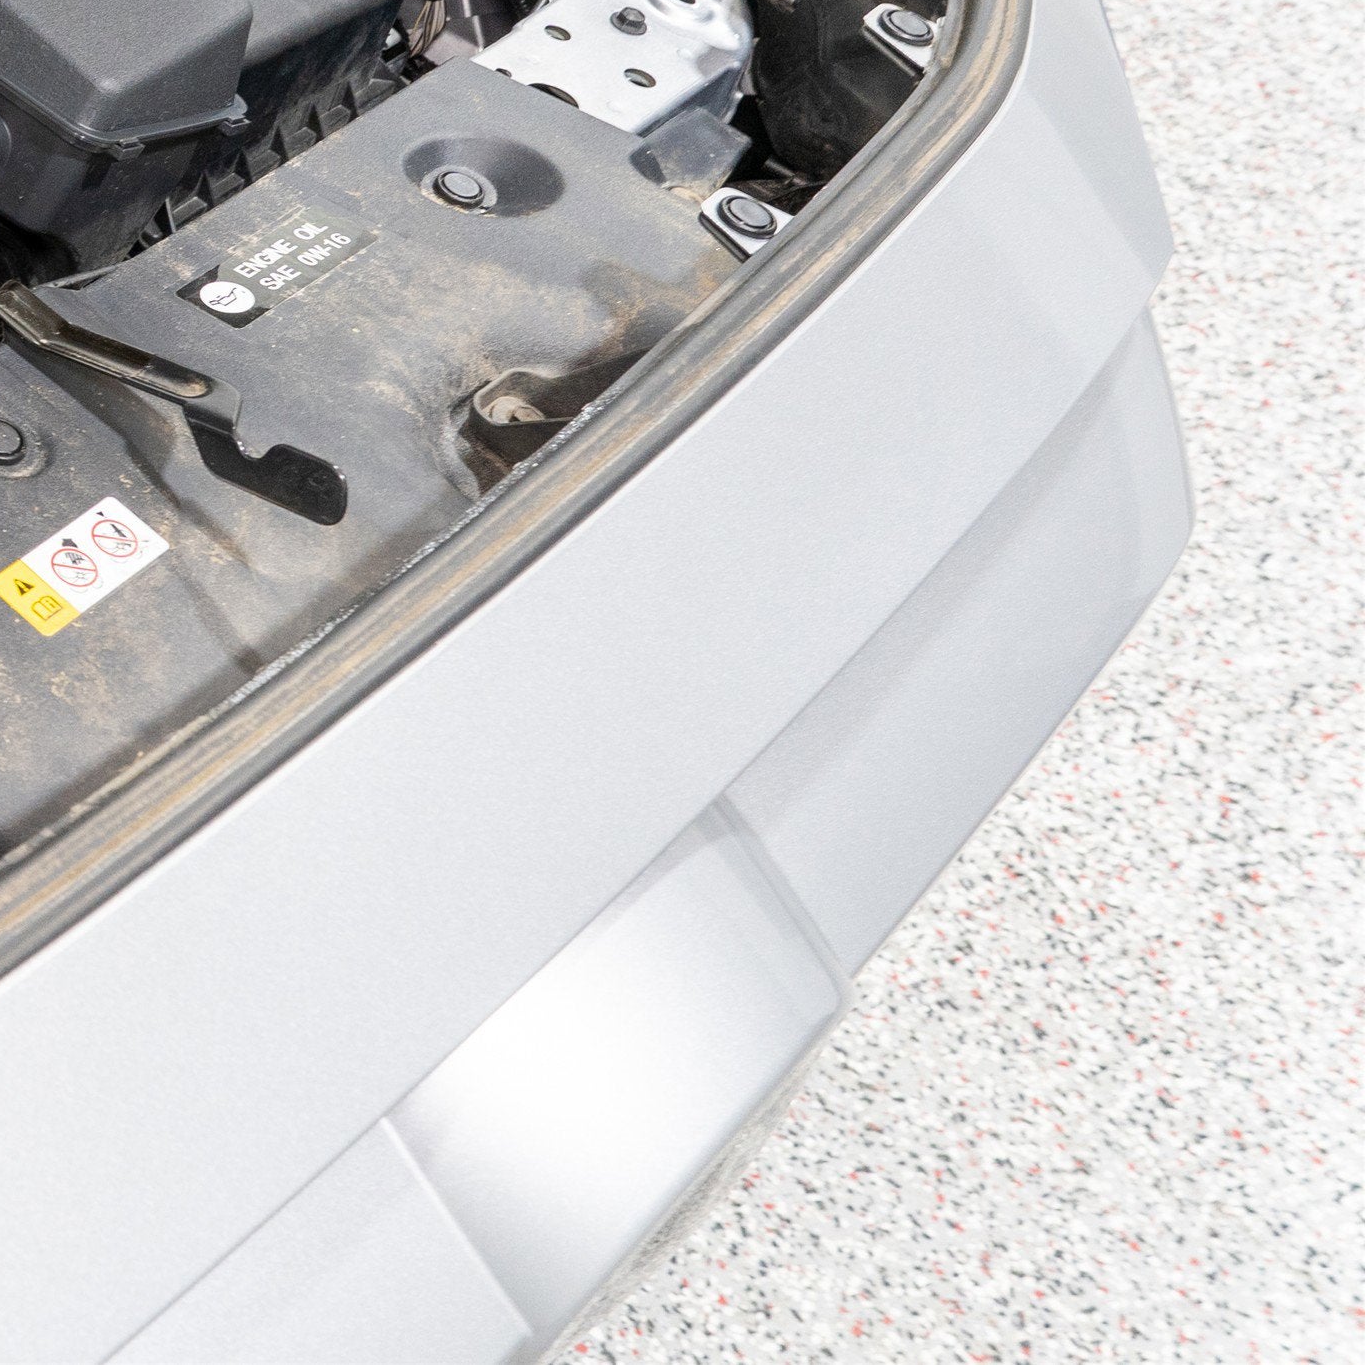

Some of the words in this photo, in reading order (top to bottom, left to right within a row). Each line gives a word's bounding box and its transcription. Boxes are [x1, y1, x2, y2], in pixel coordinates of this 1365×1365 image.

[233, 238, 299, 279] ENGINE
[293, 222, 330, 241] OIL
[259, 264, 302, 291] SAE
[297, 232, 352, 267] 0W-16
